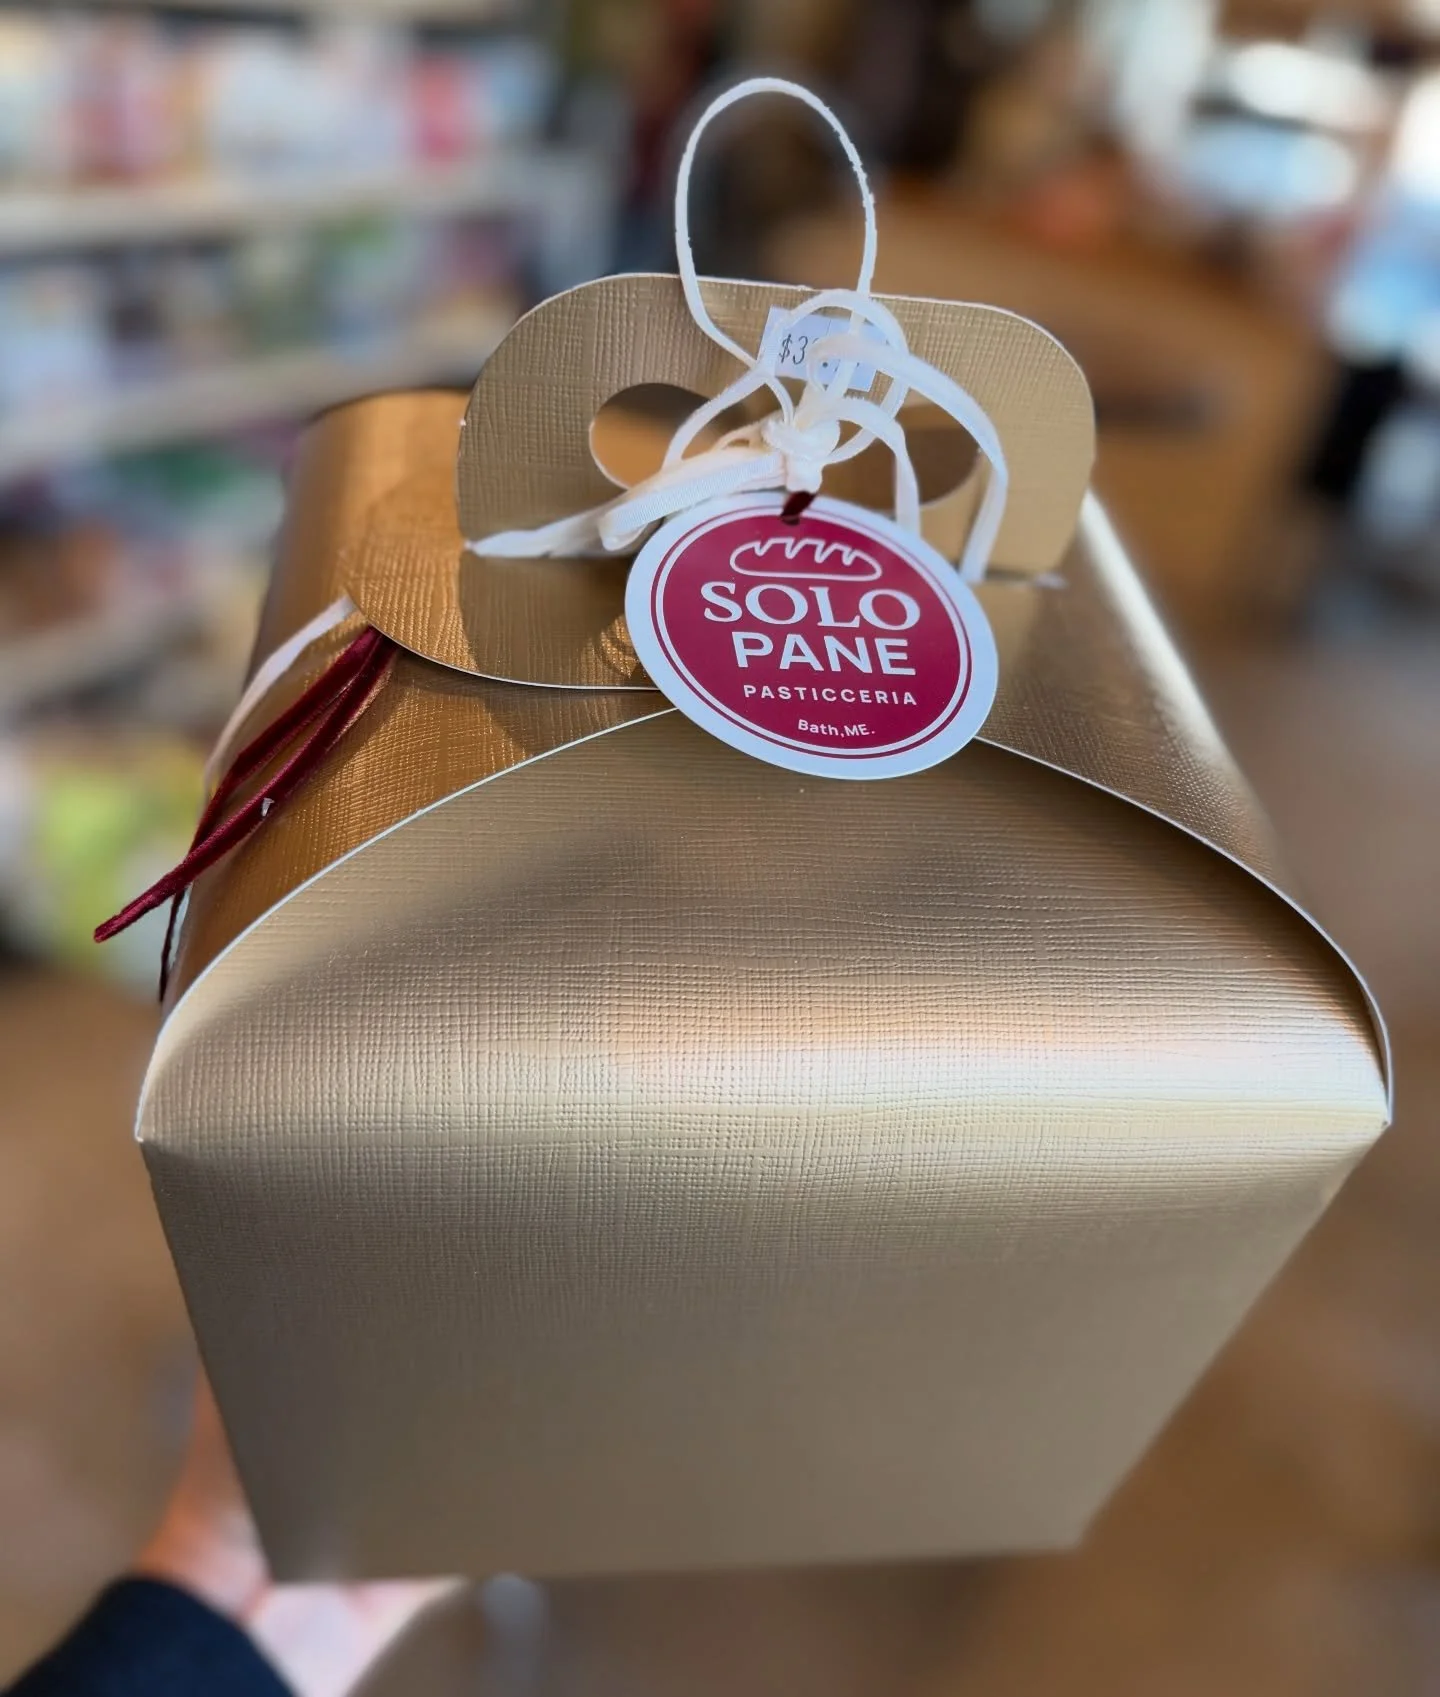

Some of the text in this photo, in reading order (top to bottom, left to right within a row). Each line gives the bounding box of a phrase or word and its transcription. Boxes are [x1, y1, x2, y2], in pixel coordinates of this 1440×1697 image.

[700, 581, 921, 631] SOLO
[731, 630, 917, 676] PANE
[742, 684, 918, 706] PASTICCERIA
